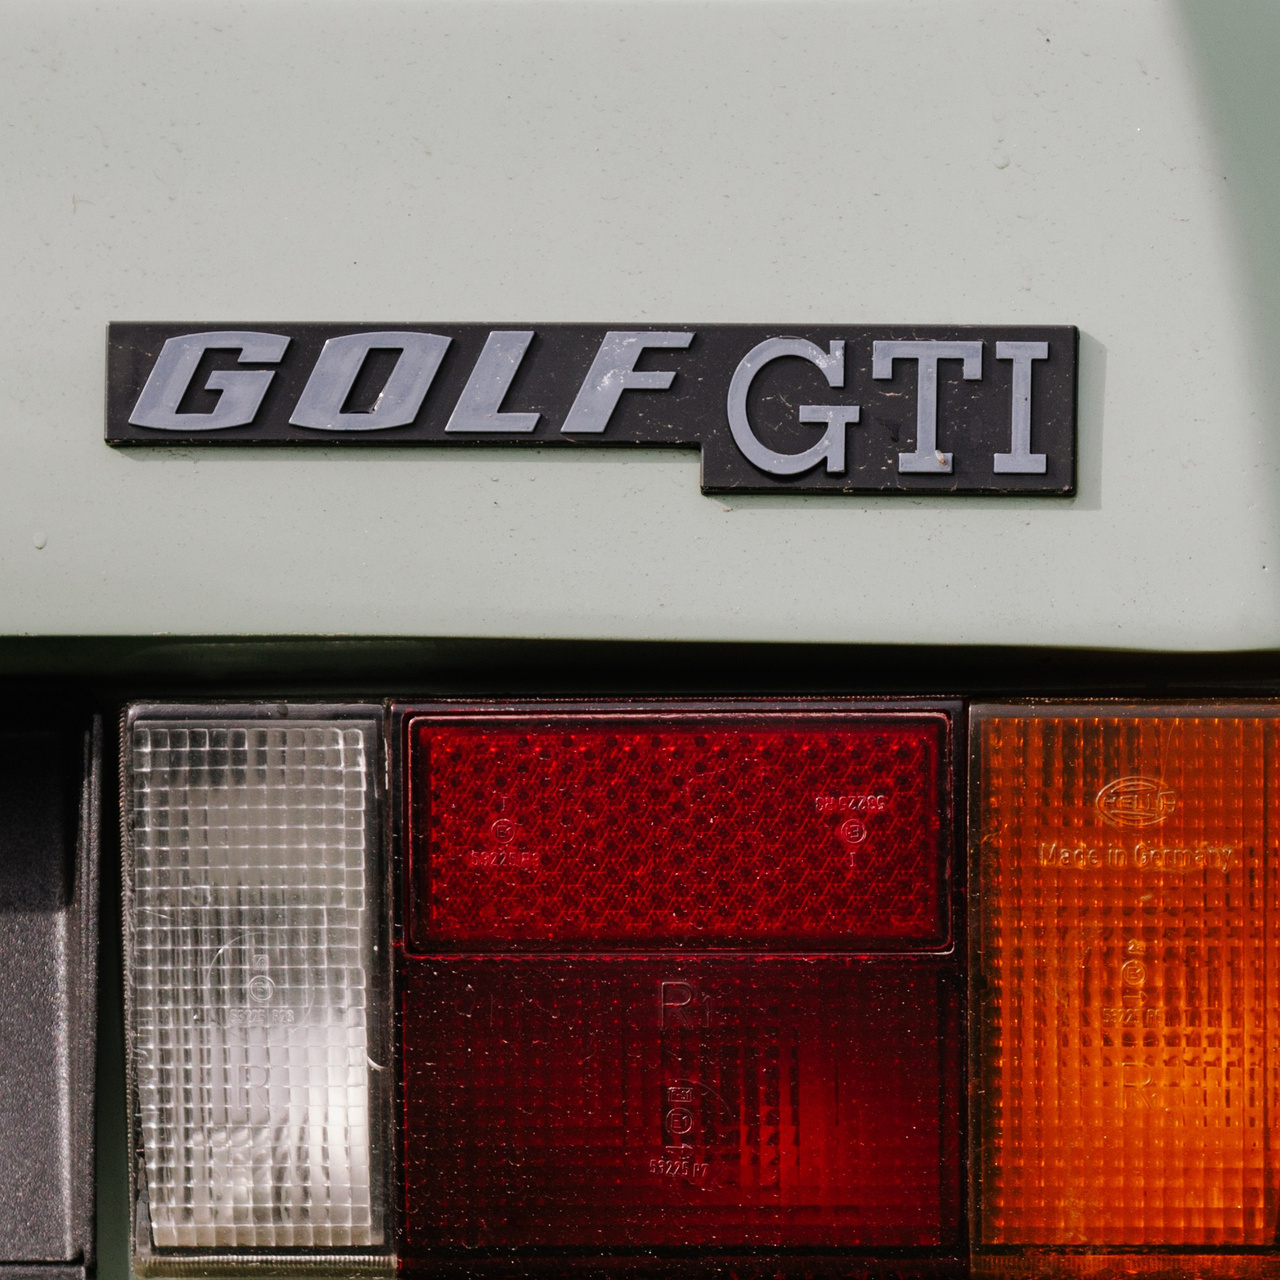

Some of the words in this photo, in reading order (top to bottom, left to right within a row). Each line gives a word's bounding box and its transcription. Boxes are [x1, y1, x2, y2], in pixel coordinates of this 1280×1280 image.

[128, 329, 694, 433] GOLF
[726, 336, 1050, 475] GTI
[1102, 790, 1177, 814] HELLA
[1040, 843, 1099, 866] Made
[1108, 843, 1127, 866] in
[1134, 842, 1233, 871] Germany
